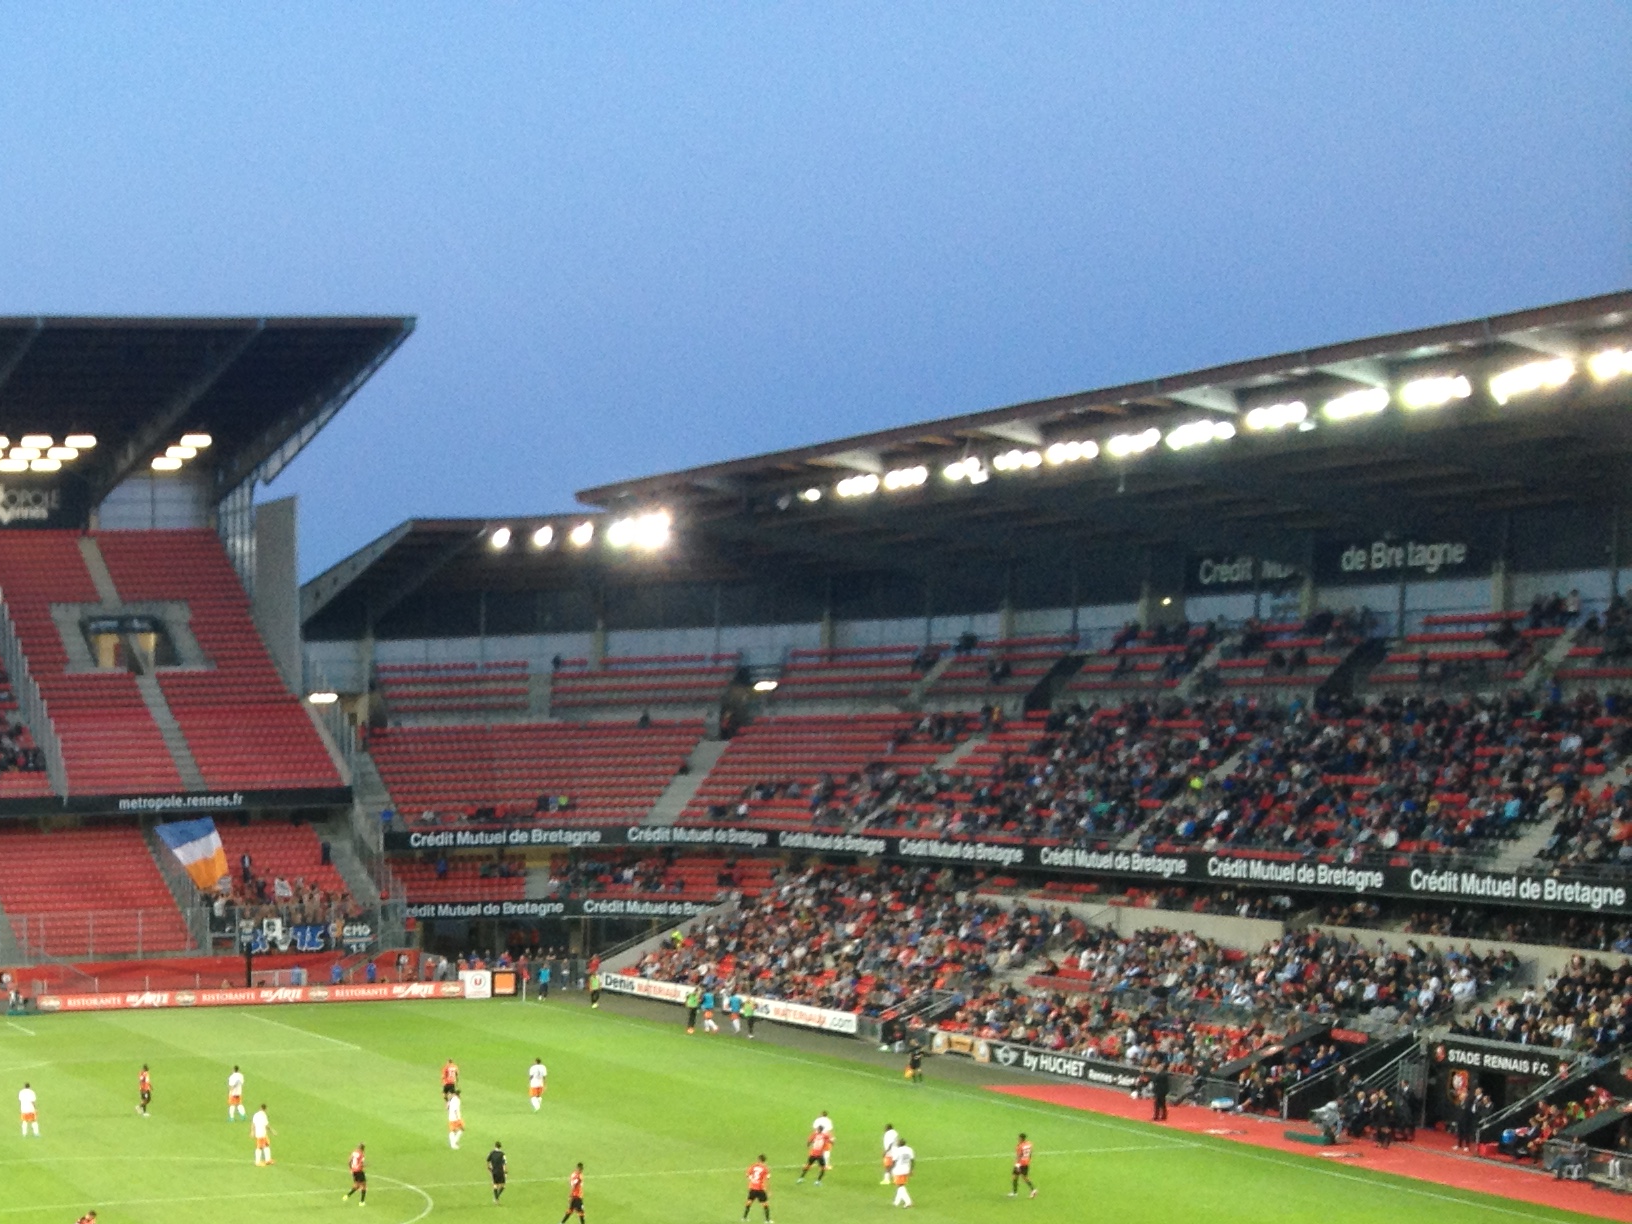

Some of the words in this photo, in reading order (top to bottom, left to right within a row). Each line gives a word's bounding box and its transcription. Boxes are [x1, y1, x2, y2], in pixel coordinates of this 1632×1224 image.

[1341, 546, 1367, 572] de
[119, 792, 244, 811] metropole.rennes.fr
[410, 832, 454, 847] Crédit
[456, 830, 507, 845] Mutuel
[509, 829, 529, 843] de
[531, 829, 602, 846] Bretagne
[627, 826, 670, 842] Crédit
[672, 827, 714, 842] Mutuel
[715, 828, 728, 842] de
[729, 828, 767, 848] Bretagne
[1040, 846, 1074, 867] Crédit
[1075, 849, 1114, 869] Mutuel
[1115, 851, 1130, 870] de
[1131, 853, 1187, 877] Bretagne
[1207, 856, 1248, 878] Crédit
[1249, 859, 1296, 882] Mutuel
[1297, 864, 1315, 884] de
[1317, 864, 1384, 892] Bretagne
[1410, 868, 1459, 893] Crédit
[1461, 872, 1517, 897] Mutuel
[1519, 877, 1541, 899] de
[1543, 878, 1626, 909] Bretagne
[437, 902, 482, 917] Mutuel
[484, 901, 500, 915] de
[502, 901, 564, 918] Bretagne
[583, 899, 625, 914] Crédit
[626, 900, 668, 914] Mutuel
[669, 901, 682, 915] de
[604, 975, 635, 991] Denis
[1023, 1051, 1038, 1071] by
[1040, 1053, 1086, 1078] HUCHET
[1448, 1049, 1481, 1066] STADE
[1483, 1053, 1530, 1074] RENNAIS
[1531, 1060, 1552, 1077] F.C.
